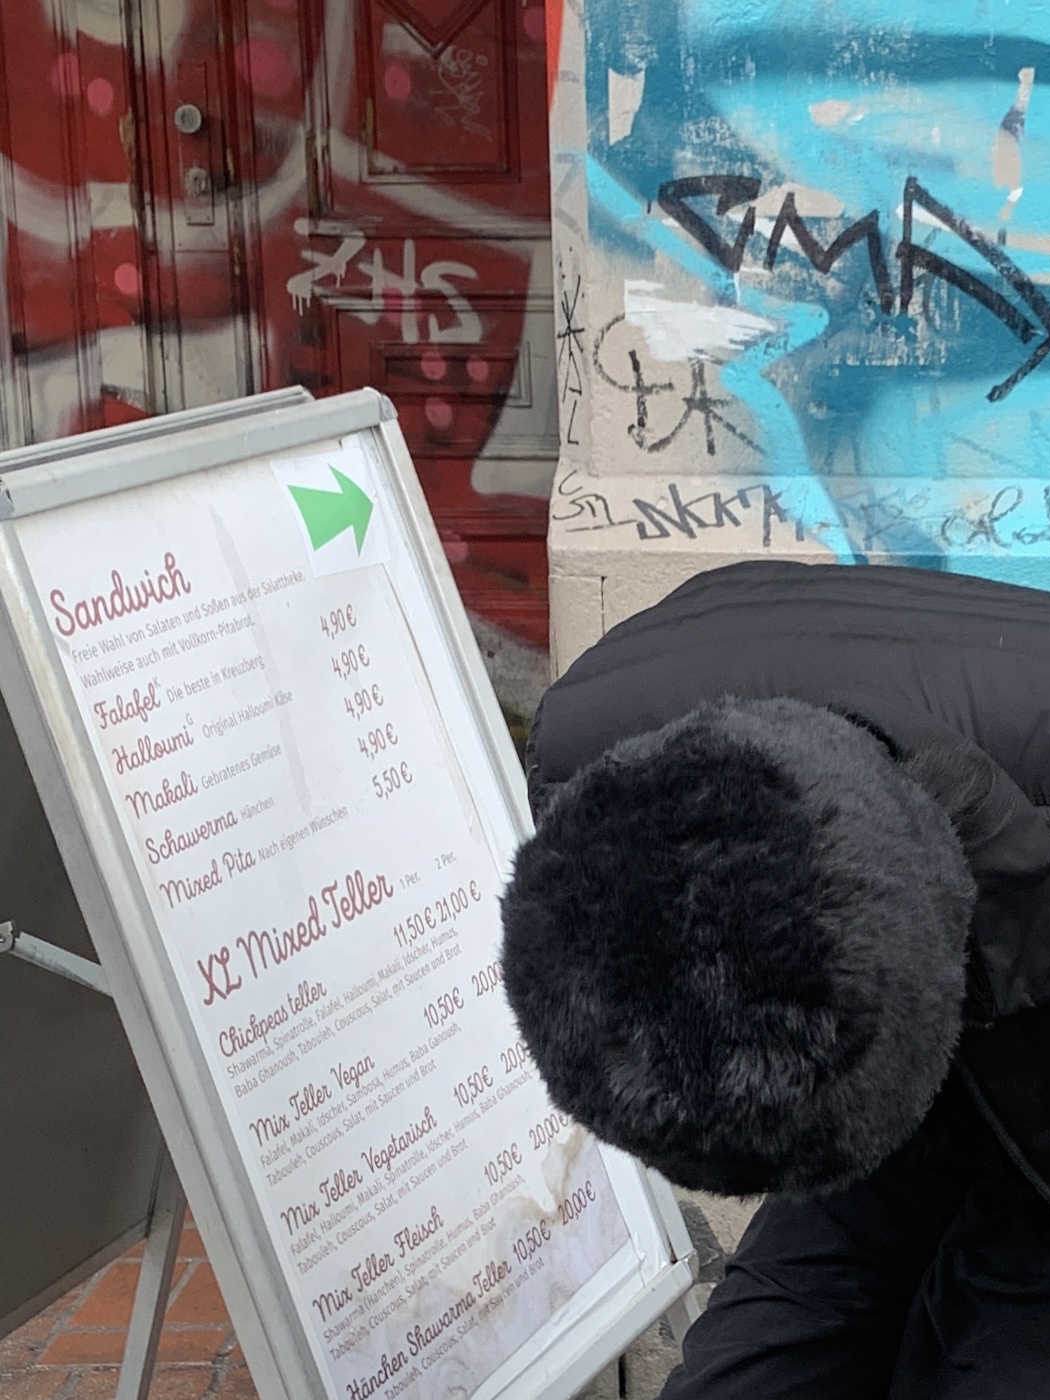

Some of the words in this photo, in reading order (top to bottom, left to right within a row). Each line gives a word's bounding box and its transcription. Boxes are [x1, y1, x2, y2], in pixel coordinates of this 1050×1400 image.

[50, 552, 191, 636] Sandwich
[93, 682, 161, 730] Falafel
[112, 725, 194, 775] Halloumi
[125, 771, 198, 819] Makali
[145, 811, 238, 865] Schawerma
[159, 858, 223, 909] Mixed
[222, 848, 256, 878] Pita
[197, 946, 242, 1006] XL
[236, 895, 327, 979] Mixed
[321, 869, 394, 929] Teller
[219, 1005, 289, 1058] Chickpeas
[287, 980, 332, 1015] teller
[249, 1114, 290, 1147] Mix
[289, 1083, 332, 1121] Teller
[330, 1056, 375, 1090] Vegan
[280, 1202, 320, 1236] Mix
[319, 1169, 363, 1208] Teller
[360, 1106, 437, 1173] Vegetarisch
[312, 1287, 353, 1323] Mix
[351, 1253, 395, 1293] Teller
[393, 1205, 444, 1258] Fleisch
[406, 1292, 476, 1357] Shawarma
[472, 1261, 512, 1299] Teller
